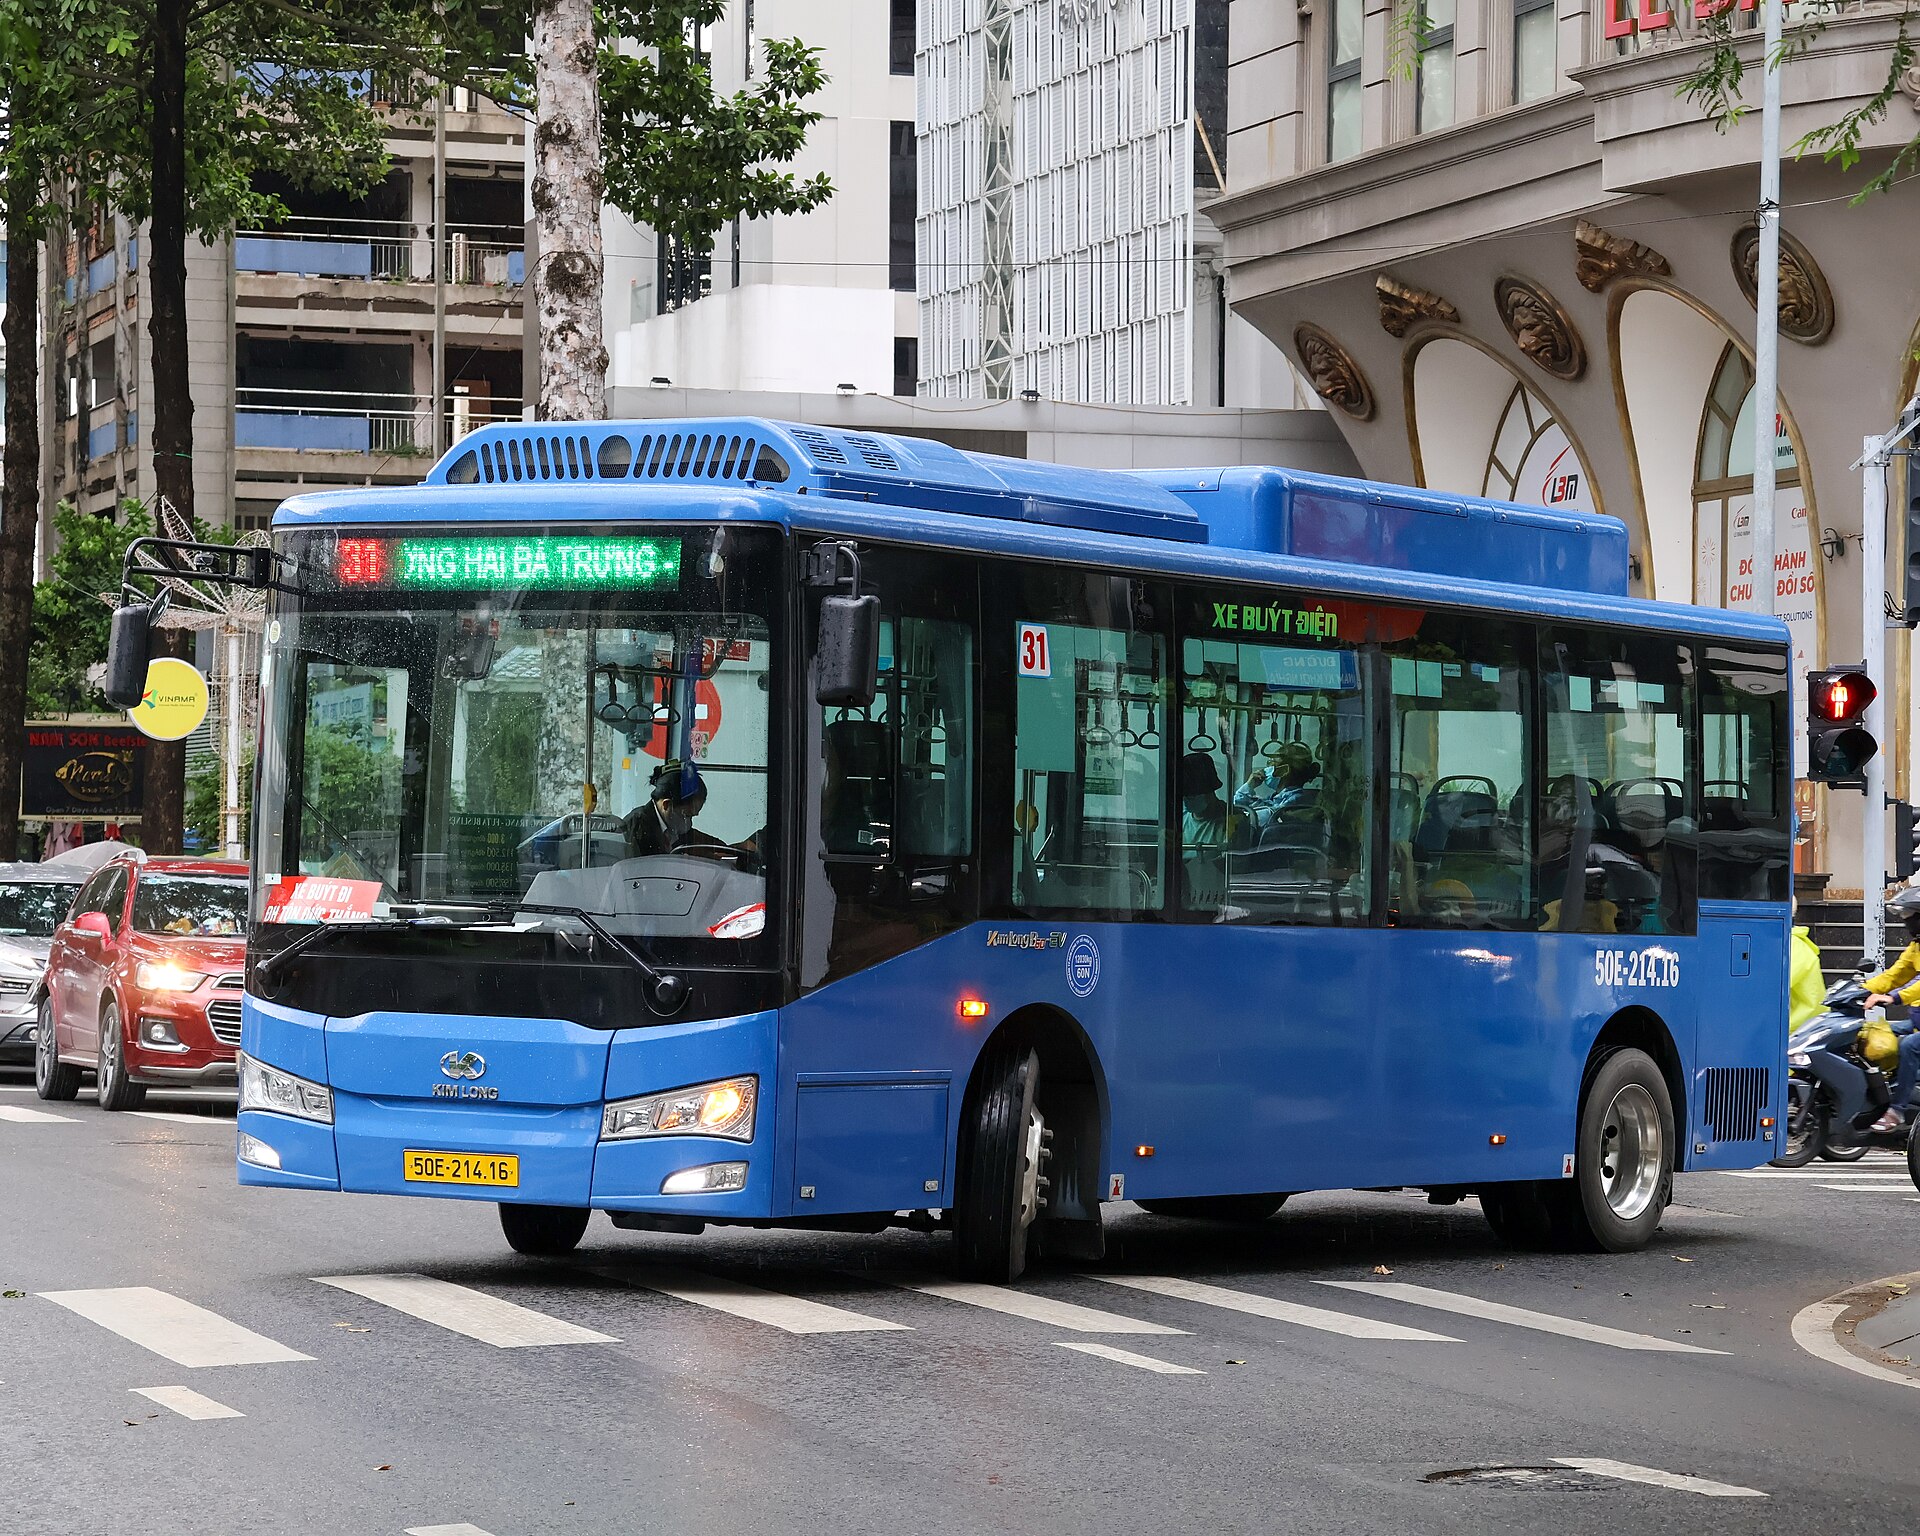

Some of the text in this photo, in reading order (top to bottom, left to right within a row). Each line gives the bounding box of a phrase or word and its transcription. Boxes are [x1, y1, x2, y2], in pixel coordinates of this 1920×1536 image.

[344, 543, 376, 579] 31
[1774, 548, 1806, 571] HÀNH
[1776, 571, 1798, 596] ĐỔI
[1212, 602, 1238, 629] XE
[1242, 601, 1292, 633] BUÝT
[1783, 611, 1813, 622] SOLUTIONS
[1022, 631, 1046, 670] 31
[290, 881, 353, 903] XE BUÝT ĐI
[1595, 950, 1680, 987] 50E-214.16
[432, 1083, 499, 1100] KIM LONG
[413, 1156, 509, 1181] 50E-214.16
